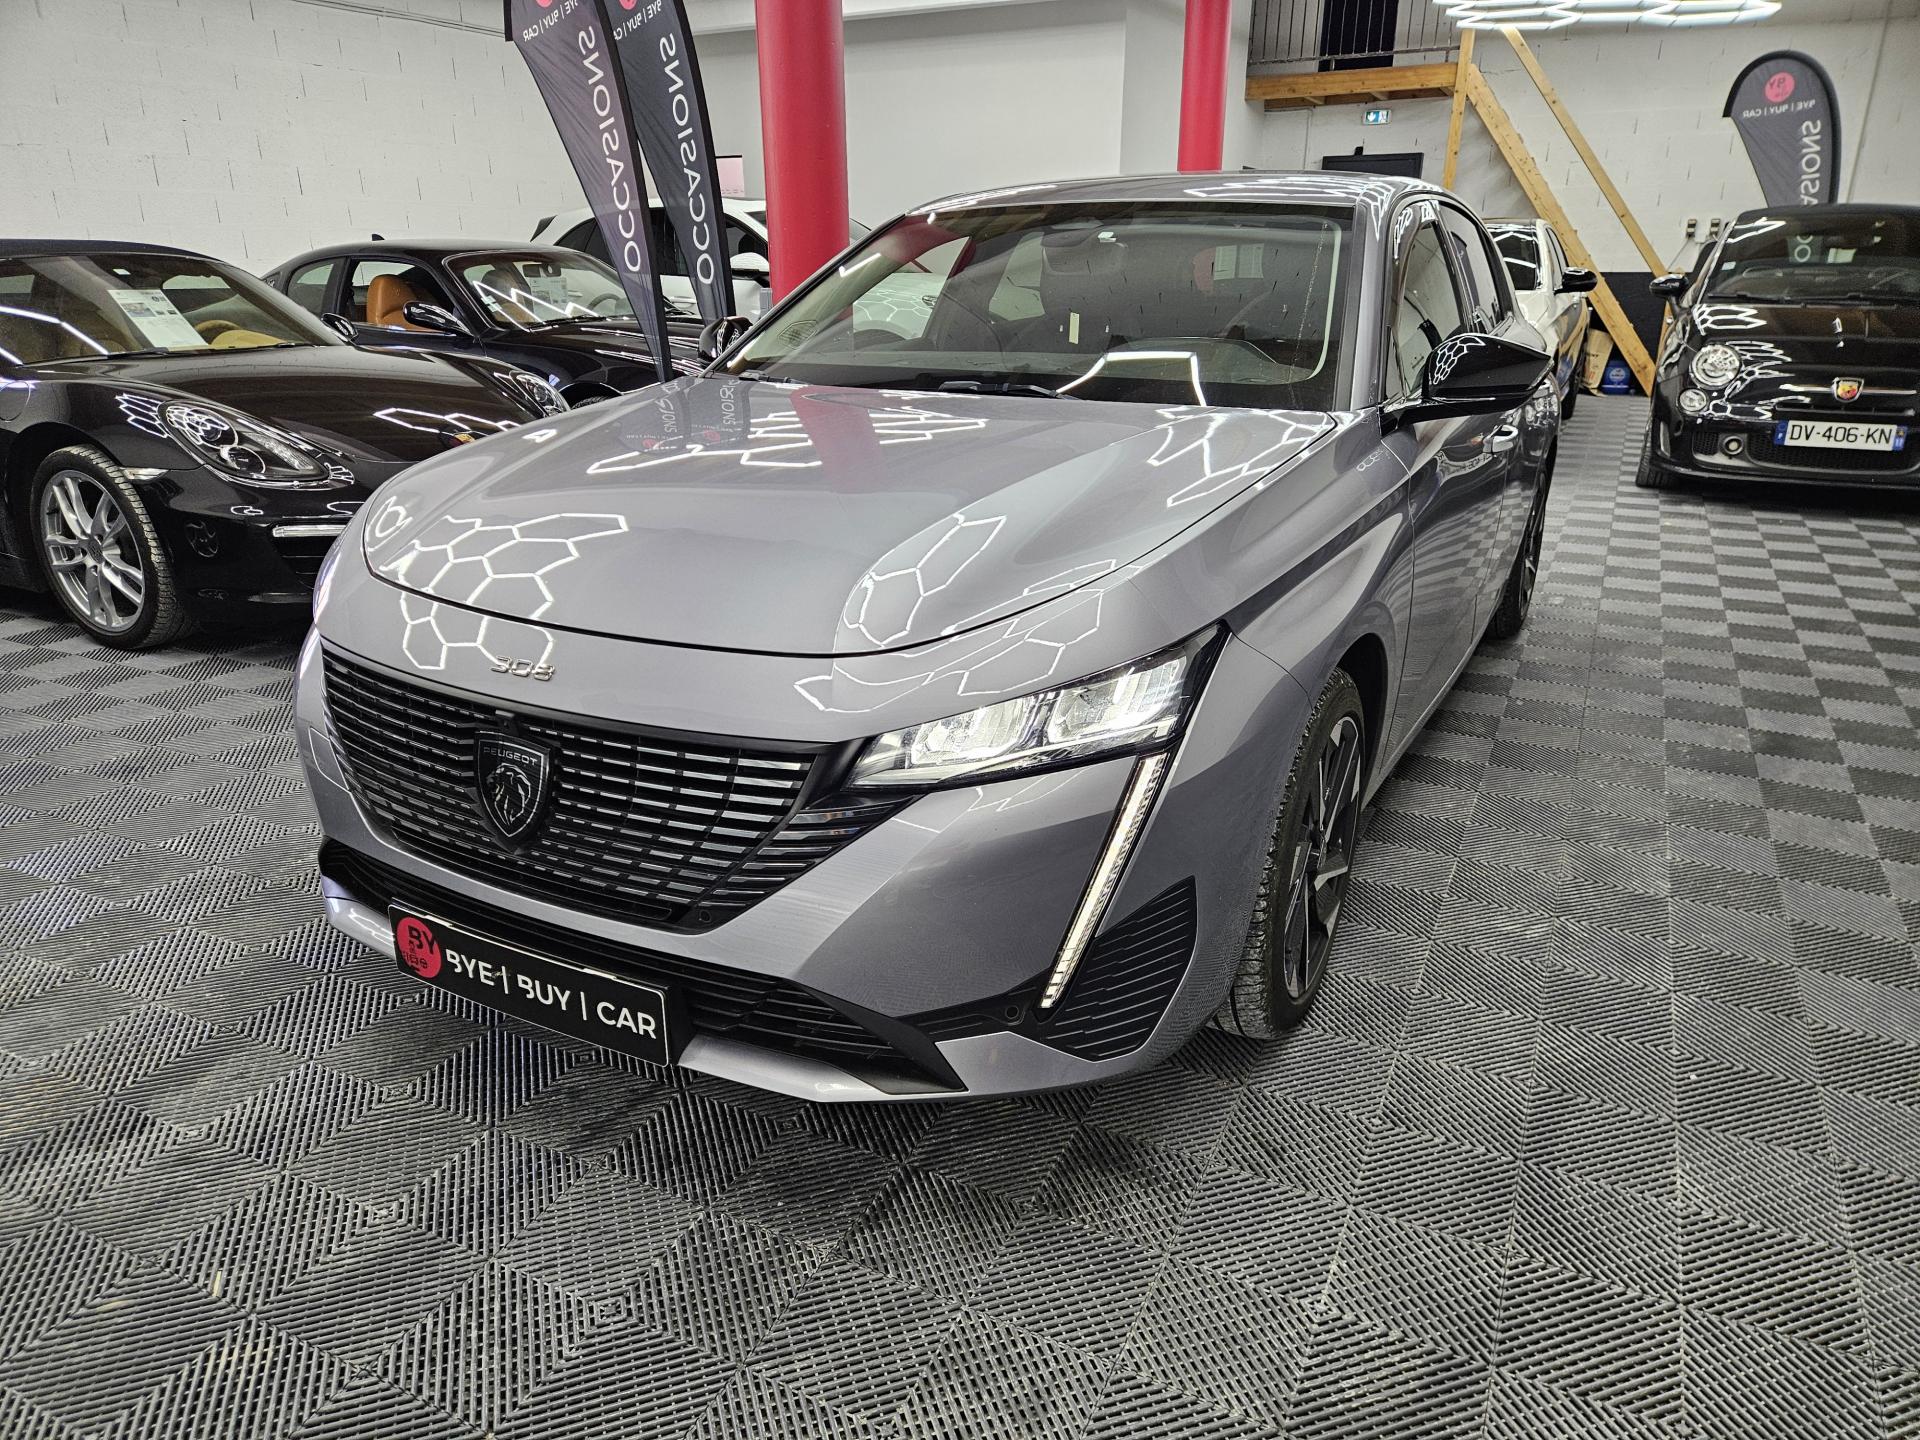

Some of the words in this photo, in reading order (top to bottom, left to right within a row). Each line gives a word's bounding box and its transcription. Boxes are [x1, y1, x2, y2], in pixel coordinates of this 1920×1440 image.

[1789, 424, 1892, 445] DV-406-KN
[490, 655, 556, 682] 308
[483, 746, 538, 767] PEUGEOT
[408, 925, 439, 955] BY
[446, 948, 495, 987] BYE
[517, 974, 571, 1011] BUY
[597, 1001, 656, 1040] CAR
